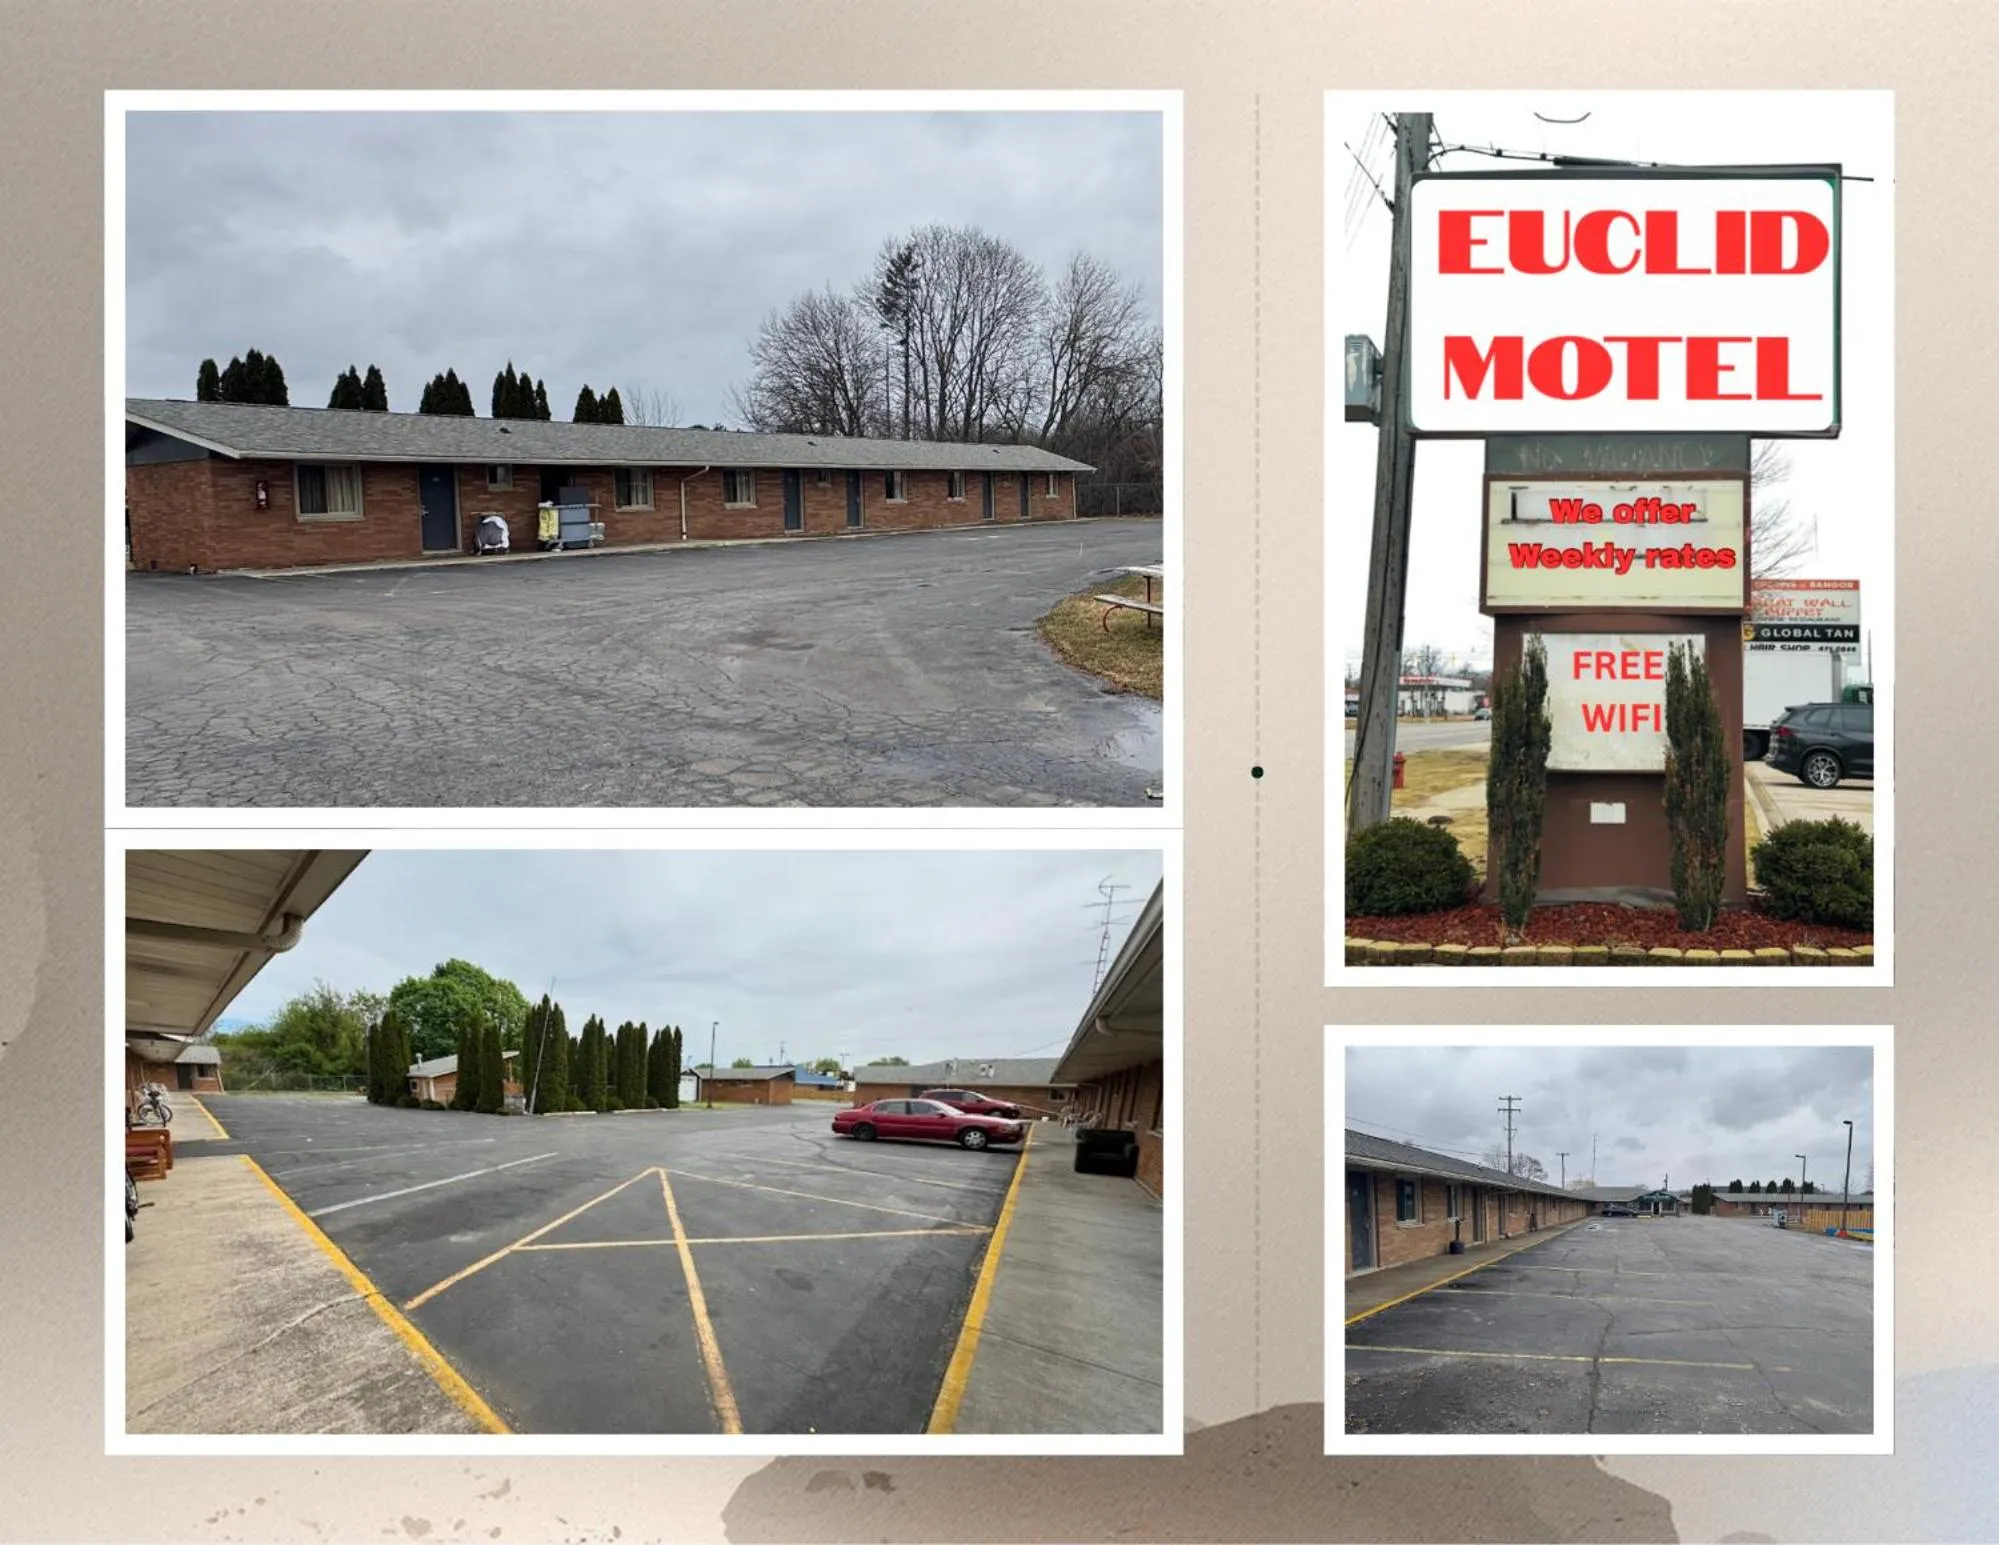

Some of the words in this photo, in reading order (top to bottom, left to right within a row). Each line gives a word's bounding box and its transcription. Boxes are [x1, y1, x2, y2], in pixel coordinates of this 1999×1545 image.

[1438, 210, 1830, 275] EUCLID
[1444, 336, 1823, 401] MOTEL
[1549, 498, 1603, 525] We
[1612, 497, 1697, 525] offer
[1508, 541, 1636, 576] Weekly
[1645, 543, 1737, 569] rates
[1761, 628, 1821, 638] GLOBAL
[1825, 629, 1854, 638] TAN
[1780, 643, 1811, 651] SHOP
[1573, 650, 1664, 681] FREE
[1582, 703, 1662, 733] WIFI
